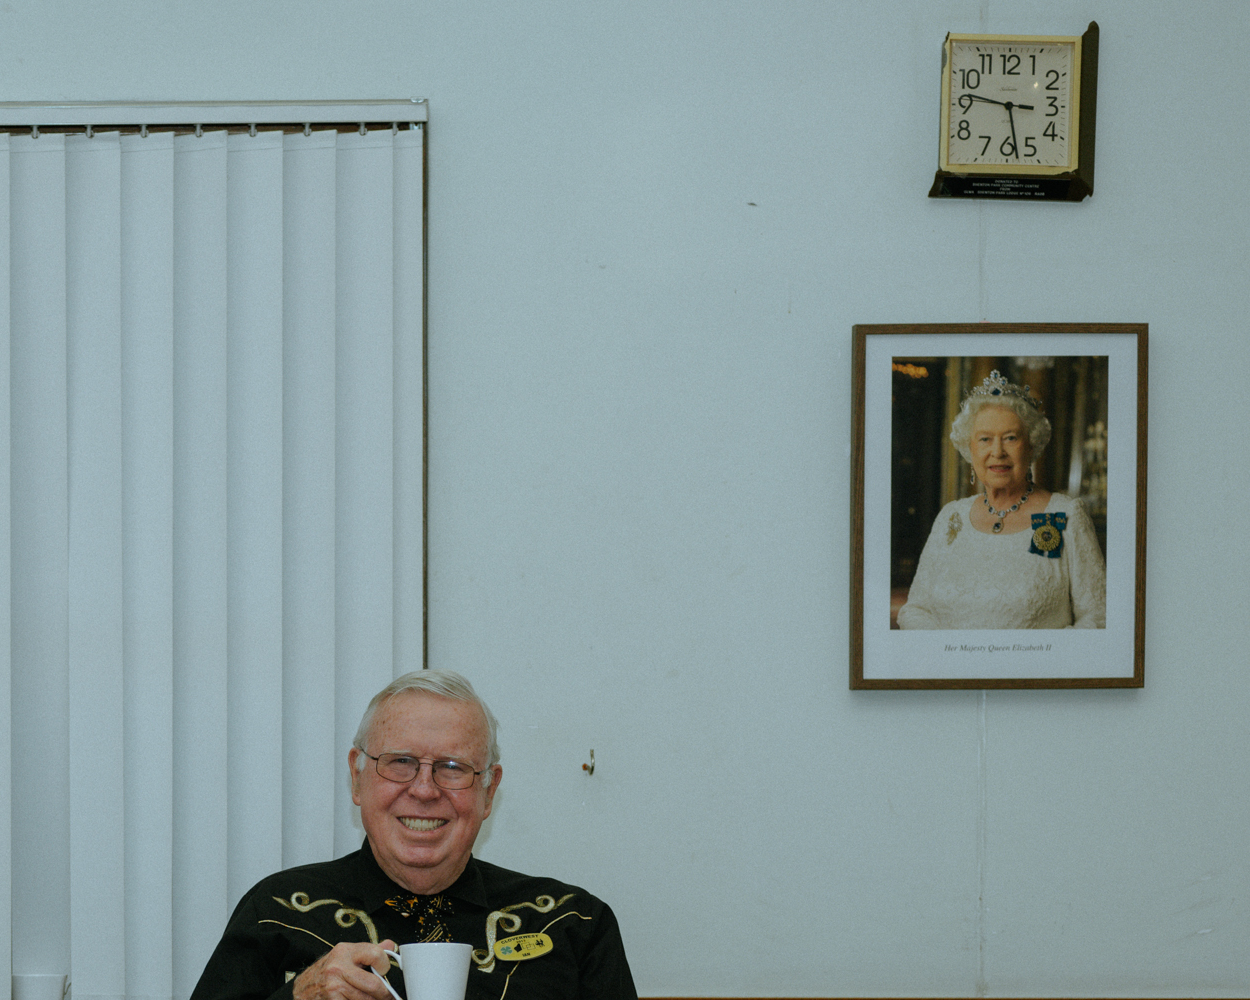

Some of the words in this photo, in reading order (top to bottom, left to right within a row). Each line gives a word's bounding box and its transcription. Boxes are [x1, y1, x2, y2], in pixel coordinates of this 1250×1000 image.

[979, 54, 992, 74] 11
[1000, 55, 1020, 75] 12
[1029, 55, 1036, 75] 1
[959, 69, 980, 89] 10
[1045, 70, 1059, 90] 2
[958, 95, 973, 114] 9
[1045, 96, 1058, 116] 3
[957, 120, 971, 140] 8
[1043, 121, 1058, 141] 4
[978, 136, 991, 156] 7
[1000, 136, 1015, 156] 6
[1024, 137, 1037, 157] 5
[944, 644, 958, 652] Her
[959, 644, 986, 654] Majesty
[988, 644, 1011, 653] Queen
[1012, 643, 1044, 652] Elizabeth
[501, 934, 538, 944] CLOVERWEST
